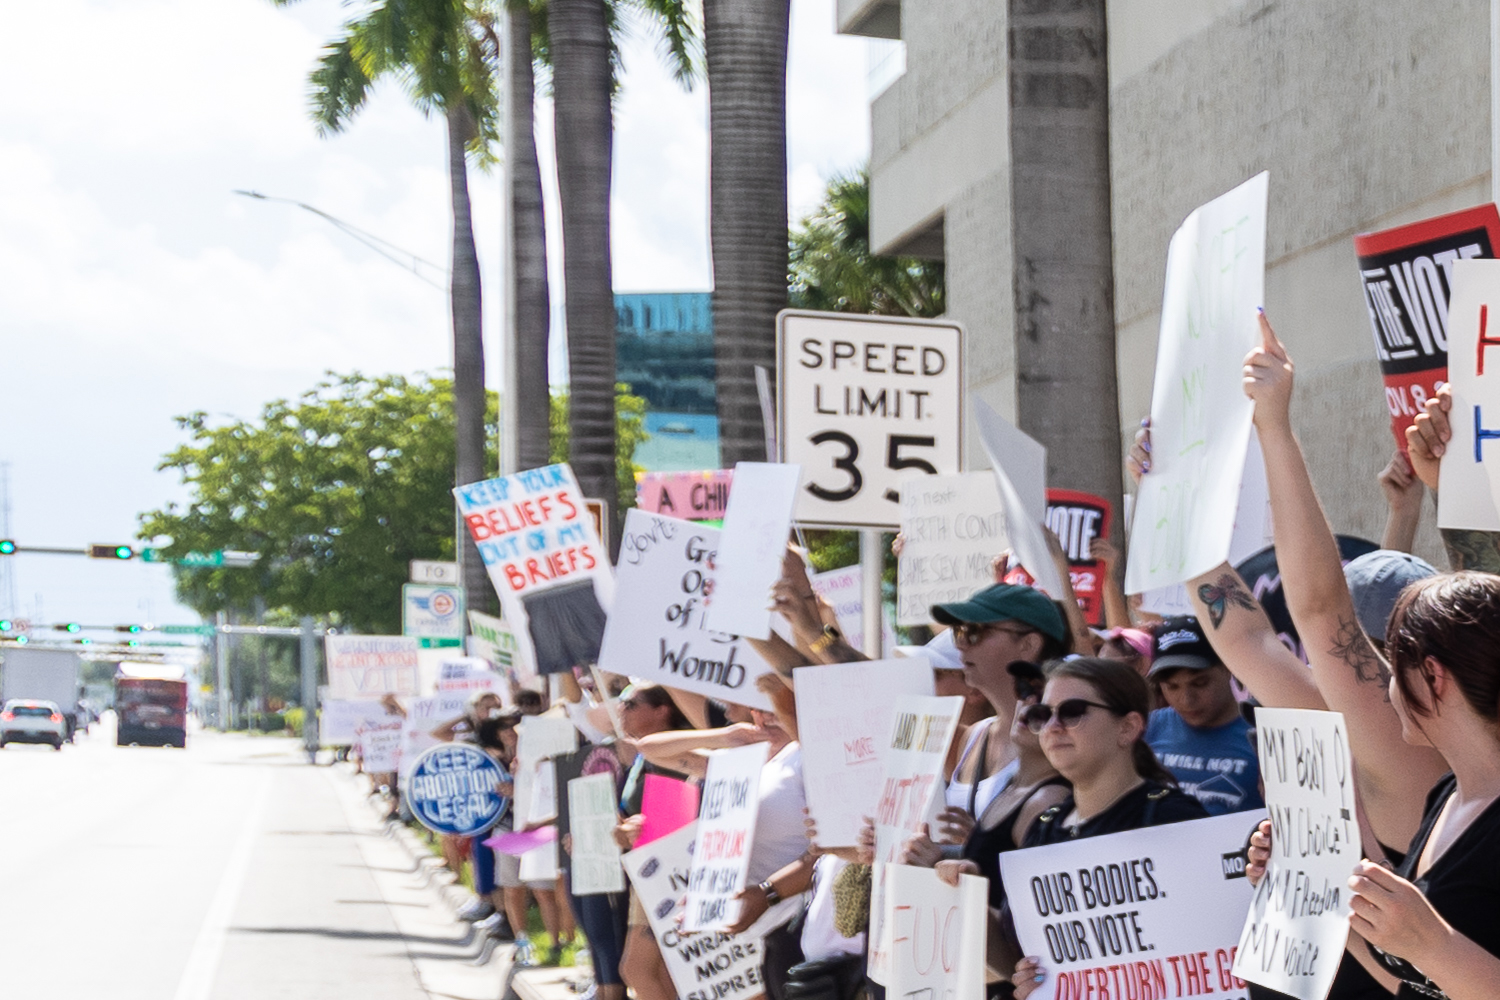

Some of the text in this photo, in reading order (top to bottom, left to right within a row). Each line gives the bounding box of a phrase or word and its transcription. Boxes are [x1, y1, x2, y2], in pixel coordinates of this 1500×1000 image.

[1366, 279, 1414, 348] THE
[1389, 243, 1483, 356] VOT
[799, 338, 946, 376] SPEED
[814, 384, 930, 420] LIMIT
[1385, 386, 1414, 418] OV.
[460, 465, 569, 509] KEEP YOUR
[804, 430, 938, 504] 35
[465, 491, 577, 541] BELIEFS
[657, 484, 675, 513] A
[477, 523, 587, 566] OUT OF MY
[503, 546, 596, 591] BRIEFS
[665, 597, 698, 629] of
[659, 637, 747, 689] Womb
[424, 748, 485, 775] KEEP
[1163, 752, 1249, 775] WILL NOT
[1262, 726, 1288, 784] MY
[412, 768, 499, 799] ABORTION
[423, 792, 497, 825] LEGAL
[1268, 803, 1292, 858] MY
[668, 867, 691, 891] I'V
[1030, 857, 1166, 917] OUR BODIES.
[1222, 855, 1245, 875] MO
[1255, 869, 1292, 913] MY
[893, 905, 959, 976] FUC
[1044, 911, 1155, 964] OUR VOTE.
[1238, 923, 1281, 973] MY
[696, 941, 757, 983] MORE
[1166, 952, 1213, 998] THE
